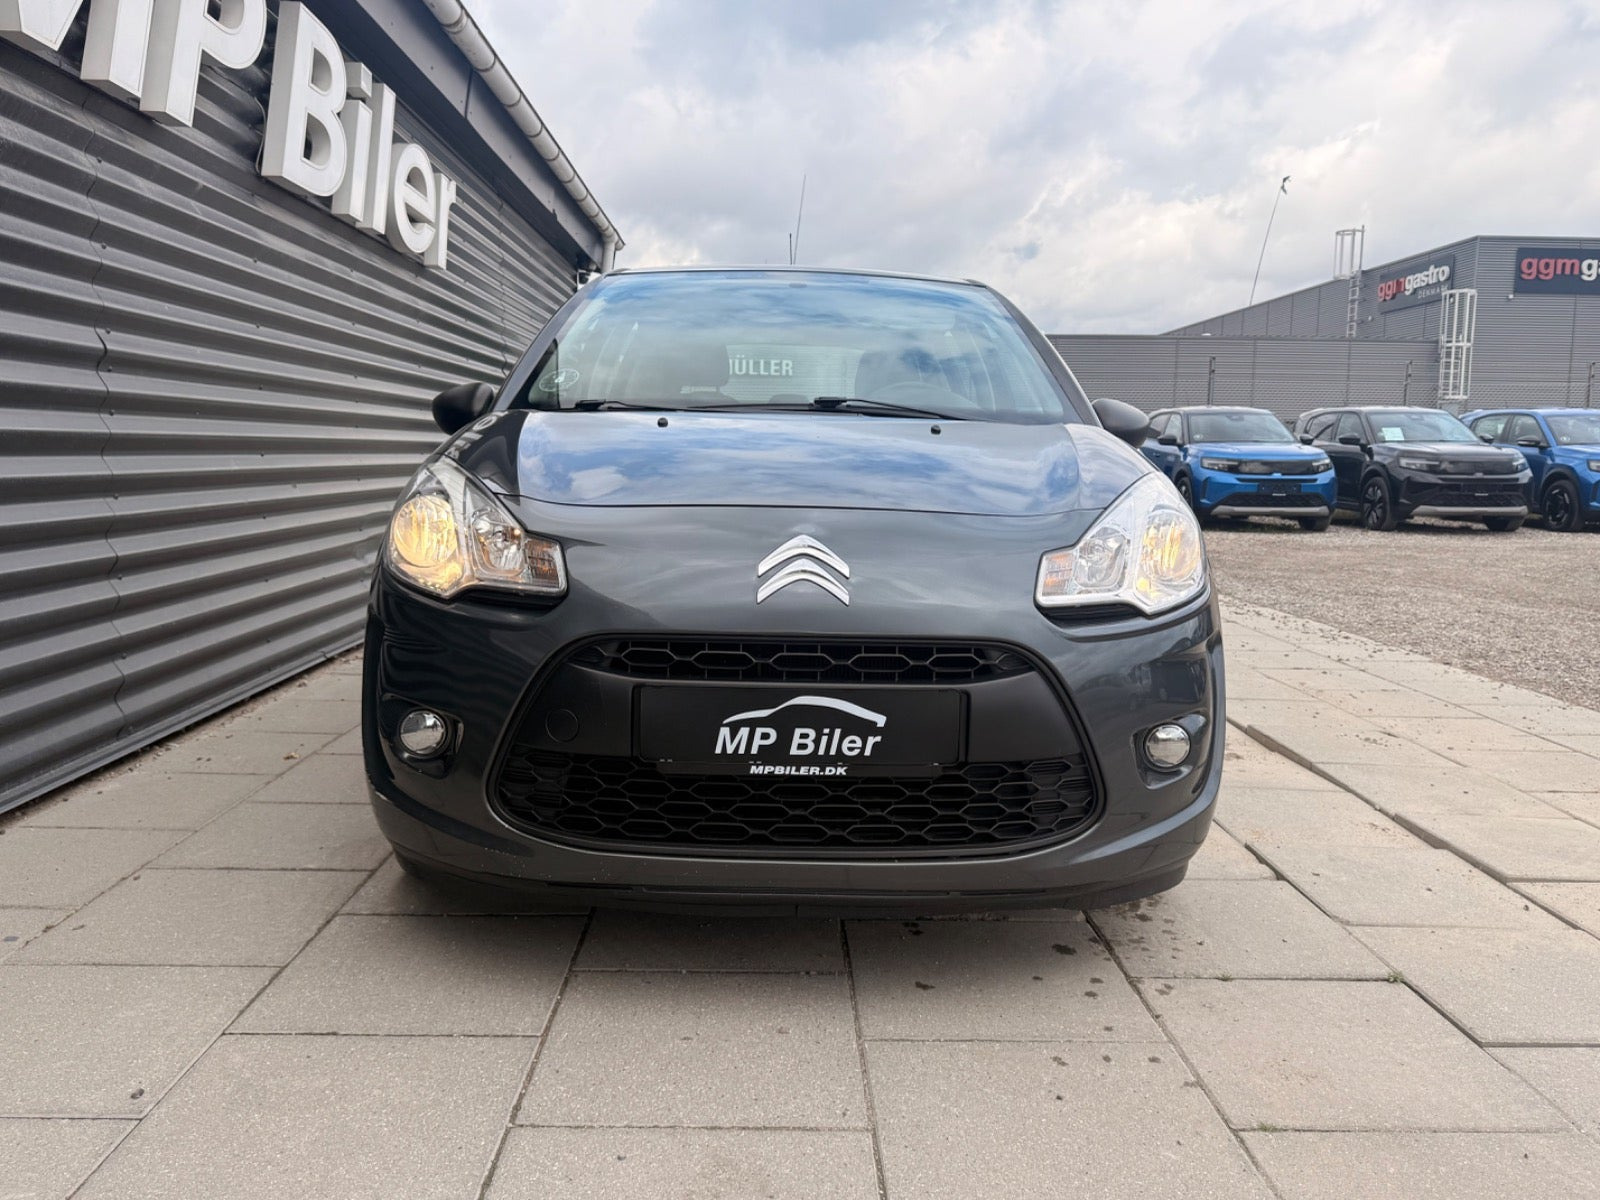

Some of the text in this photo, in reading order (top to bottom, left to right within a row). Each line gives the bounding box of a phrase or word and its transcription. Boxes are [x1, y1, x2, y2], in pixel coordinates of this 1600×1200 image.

[261, 0, 457, 271] Biler
[1520, 257, 1600, 281] ggmg
[714, 726, 882, 757] MP Biler
[749, 765, 848, 776] MPBILER.DK
